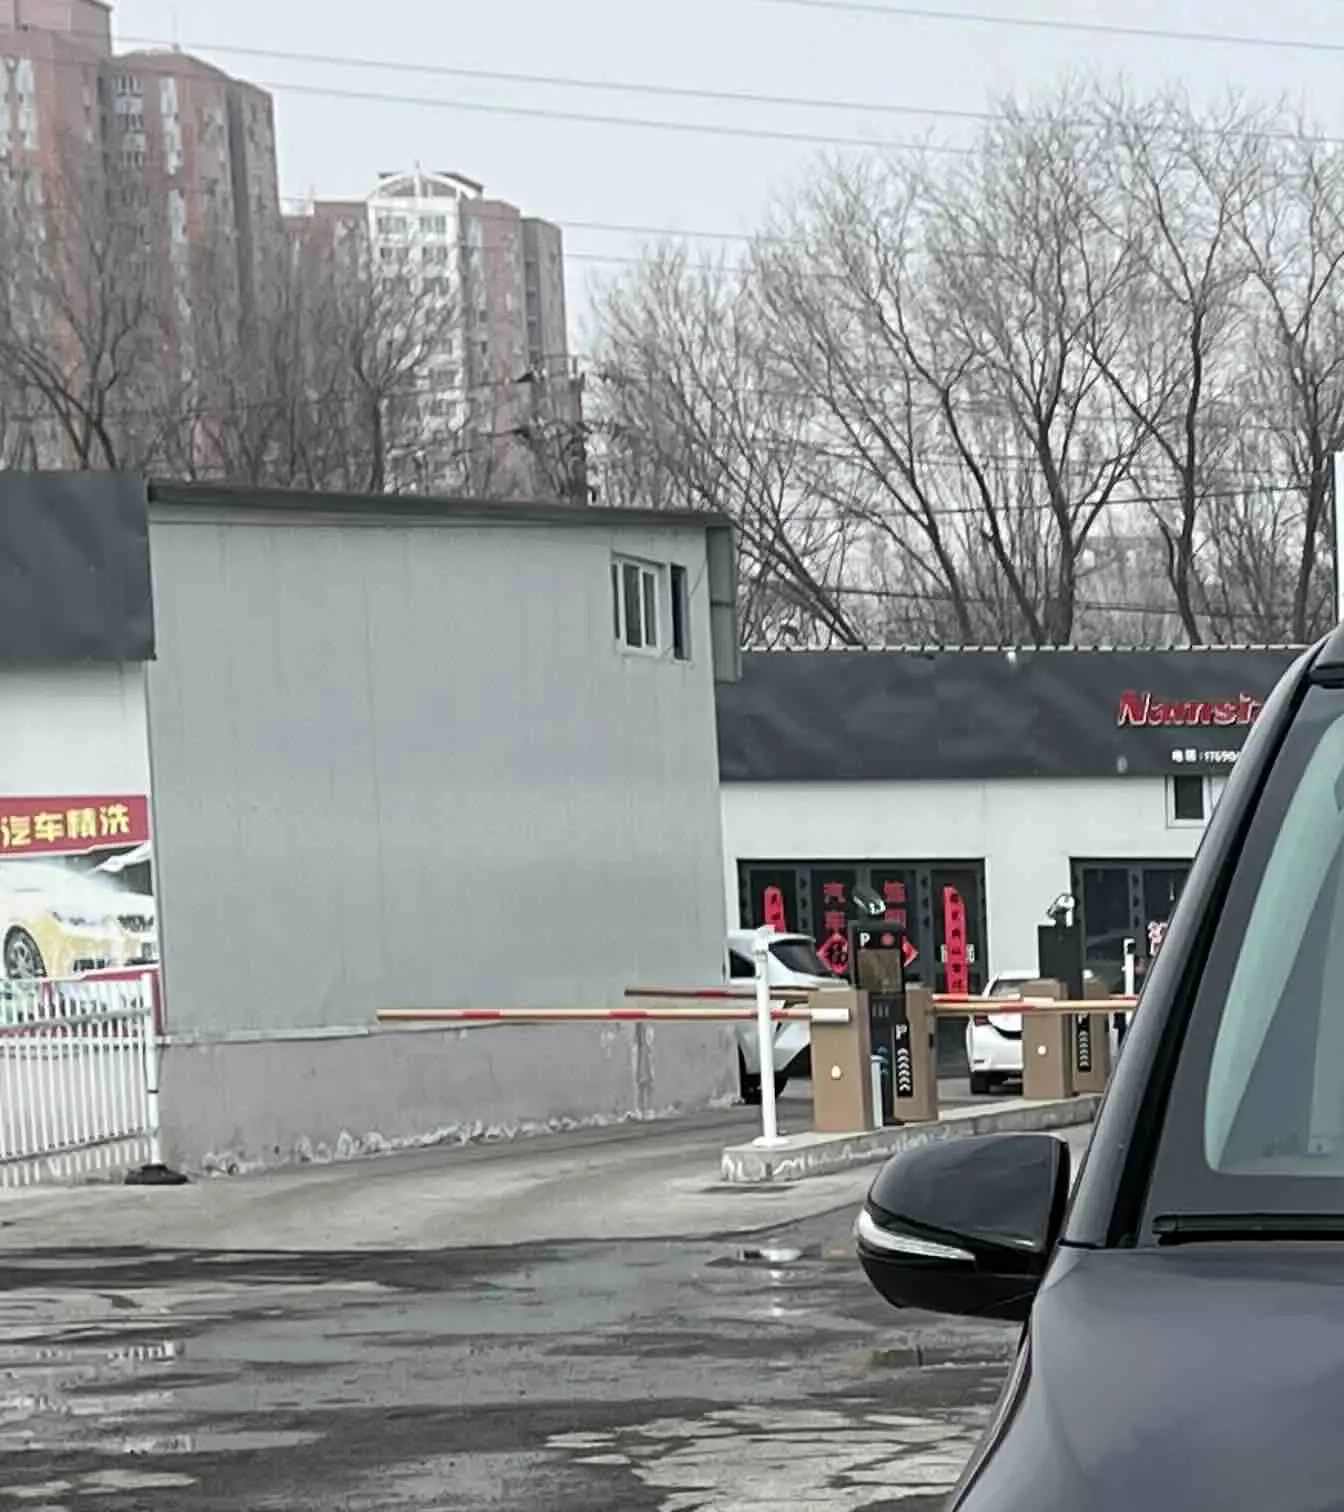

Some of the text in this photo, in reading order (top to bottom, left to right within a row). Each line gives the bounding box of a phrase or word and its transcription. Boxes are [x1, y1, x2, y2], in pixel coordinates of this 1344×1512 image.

[0, 803, 130, 848] 汽车精洗
[859, 932, 871, 947] P
